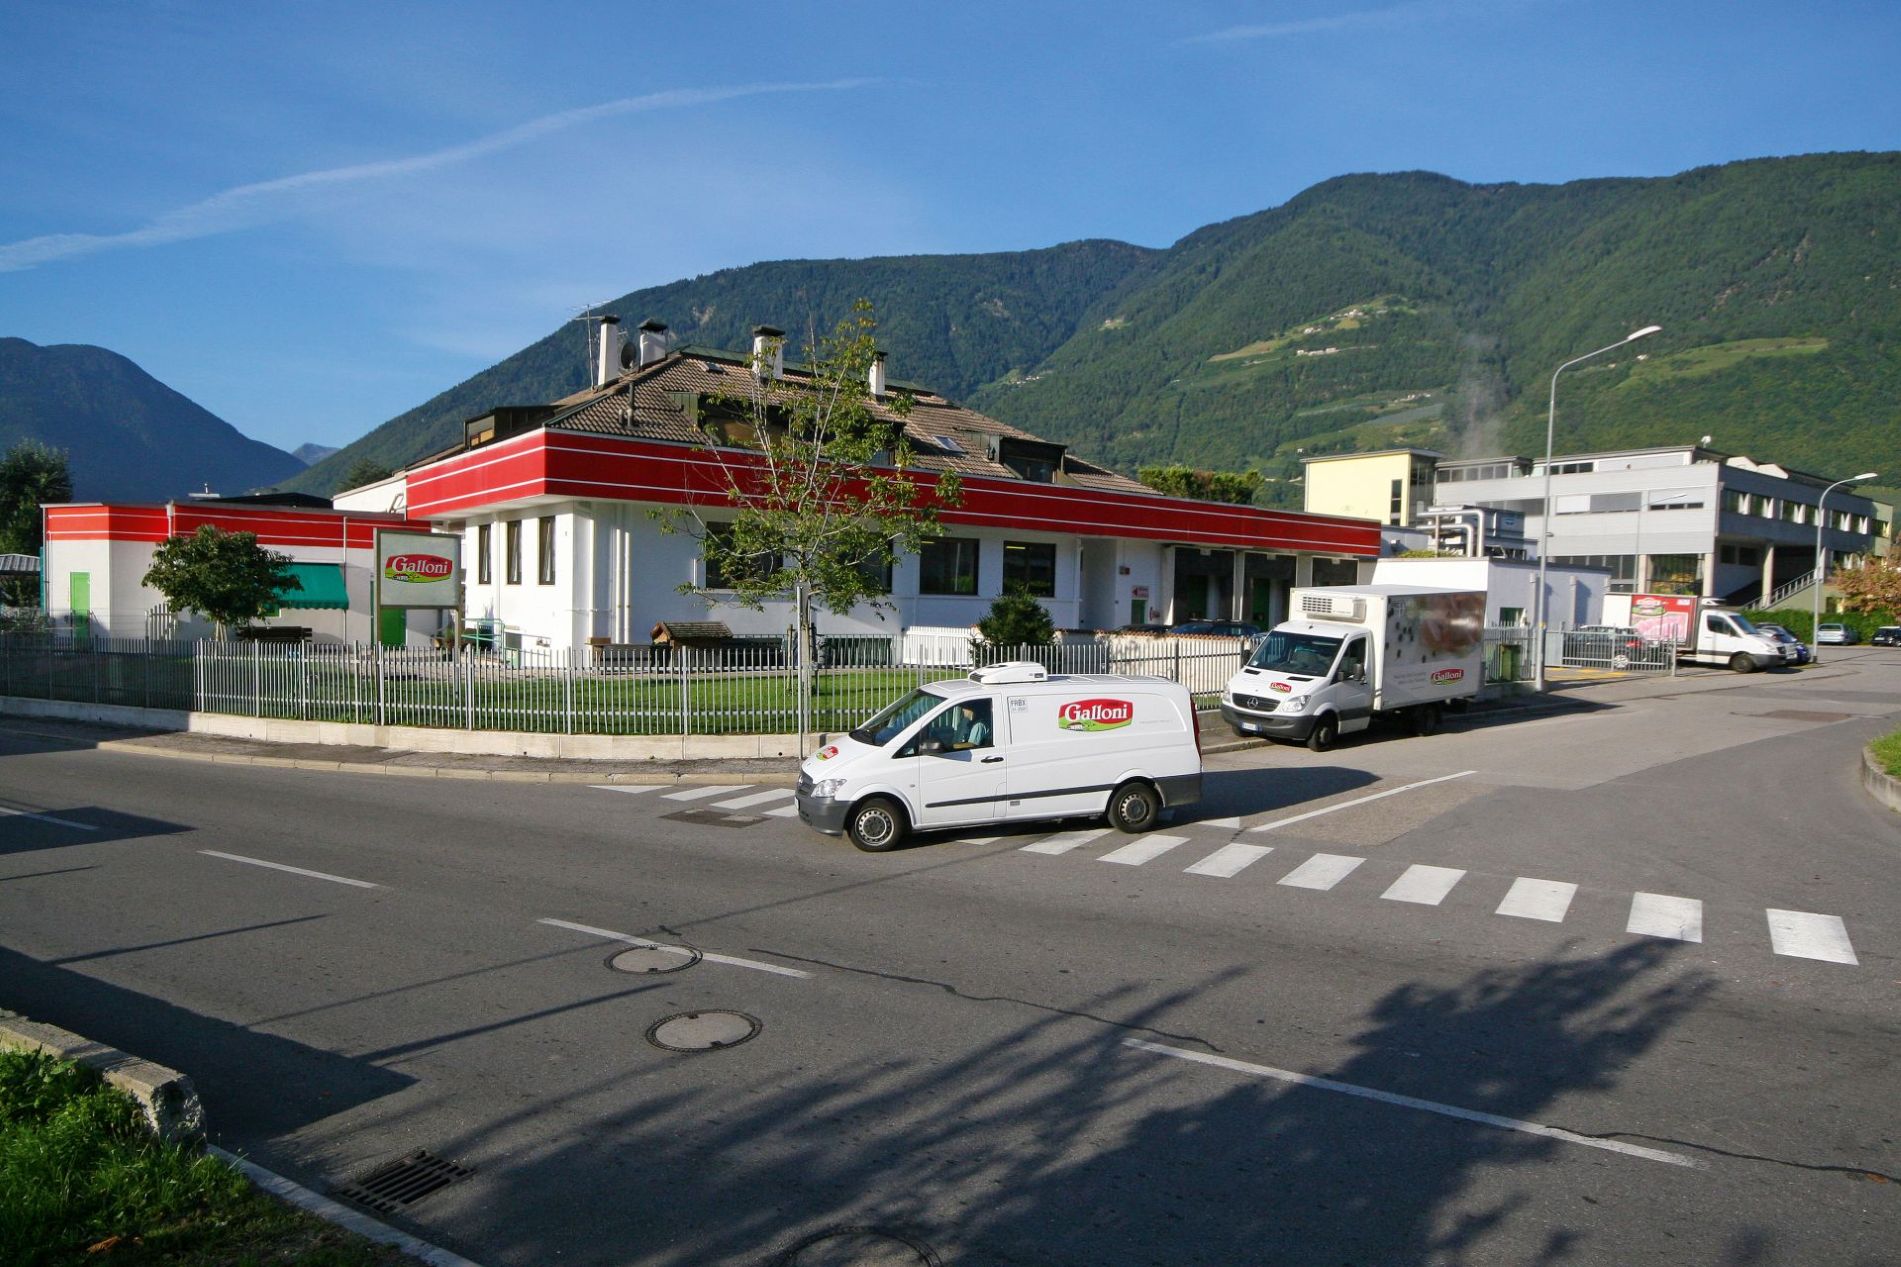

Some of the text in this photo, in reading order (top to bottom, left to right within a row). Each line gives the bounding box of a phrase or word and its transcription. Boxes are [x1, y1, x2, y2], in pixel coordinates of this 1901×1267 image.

[391, 556, 448, 574] Galloni
[1433, 670, 1462, 682] Galloni
[1064, 703, 1128, 721] Galloni
